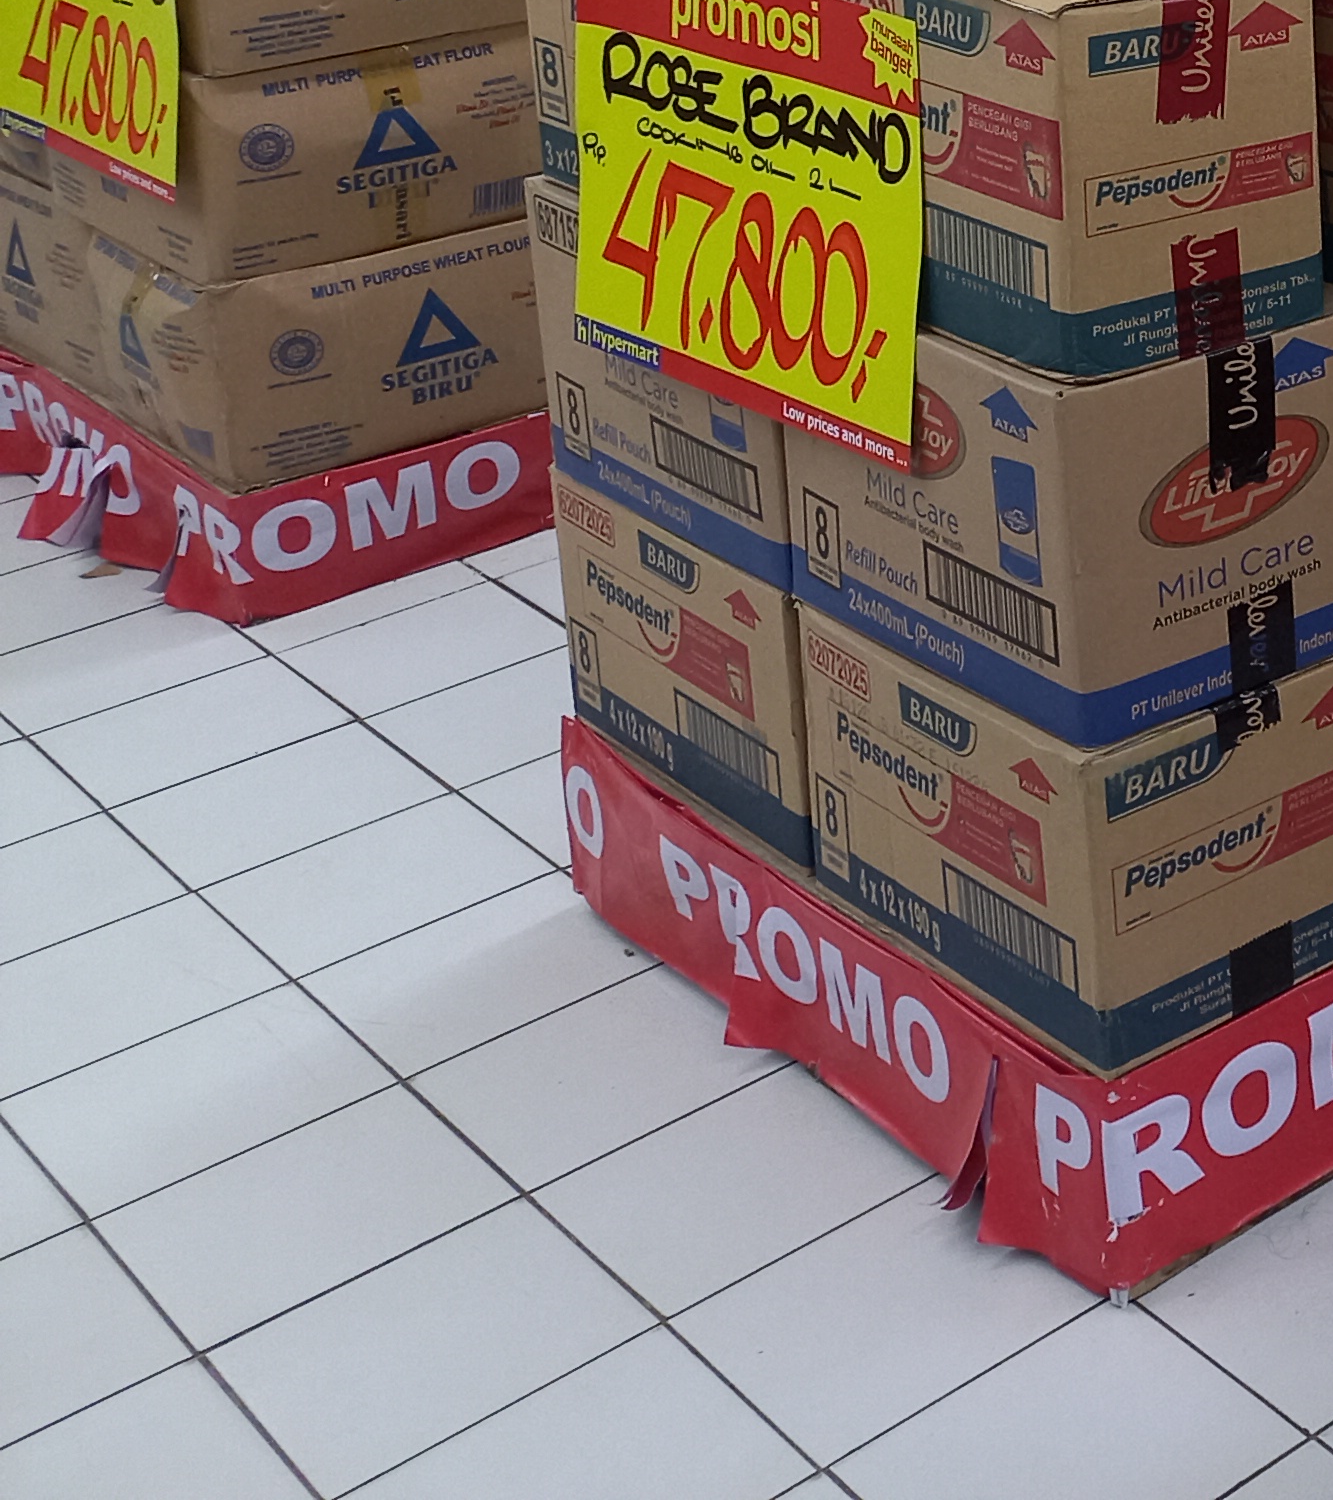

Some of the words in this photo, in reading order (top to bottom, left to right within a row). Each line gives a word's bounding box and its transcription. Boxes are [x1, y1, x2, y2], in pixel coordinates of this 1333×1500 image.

[916, 2, 972, 43] BARU
[1243, 28, 1288, 49] ATAS
[870, 36, 913, 79] banget
[1008, 51, 1042, 71] ATAS
[602, 31, 739, 134] ROSE
[742, 73, 911, 185] BRAND
[1095, 166, 1218, 208] Pepsodent
[592, 321, 661, 365] hypermart
[1092, 308, 1154, 337] Produksi
[1155, 303, 1172, 321] PT
[782, 401, 805, 424] Low
[807, 409, 840, 438] prices
[841, 422, 863, 446] and
[864, 433, 895, 461] more
[171, 439, 523, 587] PROMO
[813, 503, 829, 561] 8
[1152, 583, 1247, 632] Antibacterial
[1286, 558, 1322, 583] wash
[1158, 556, 1227, 609] Mild
[1239, 531, 1314, 581] Care
[1151, 679, 1205, 715] Unilever
[836, 711, 941, 801] Pepsodent
[1125, 753, 1213, 804] BARU
[1123, 816, 1268, 899] Pepsodent
[659, 833, 951, 1104] PROMO
